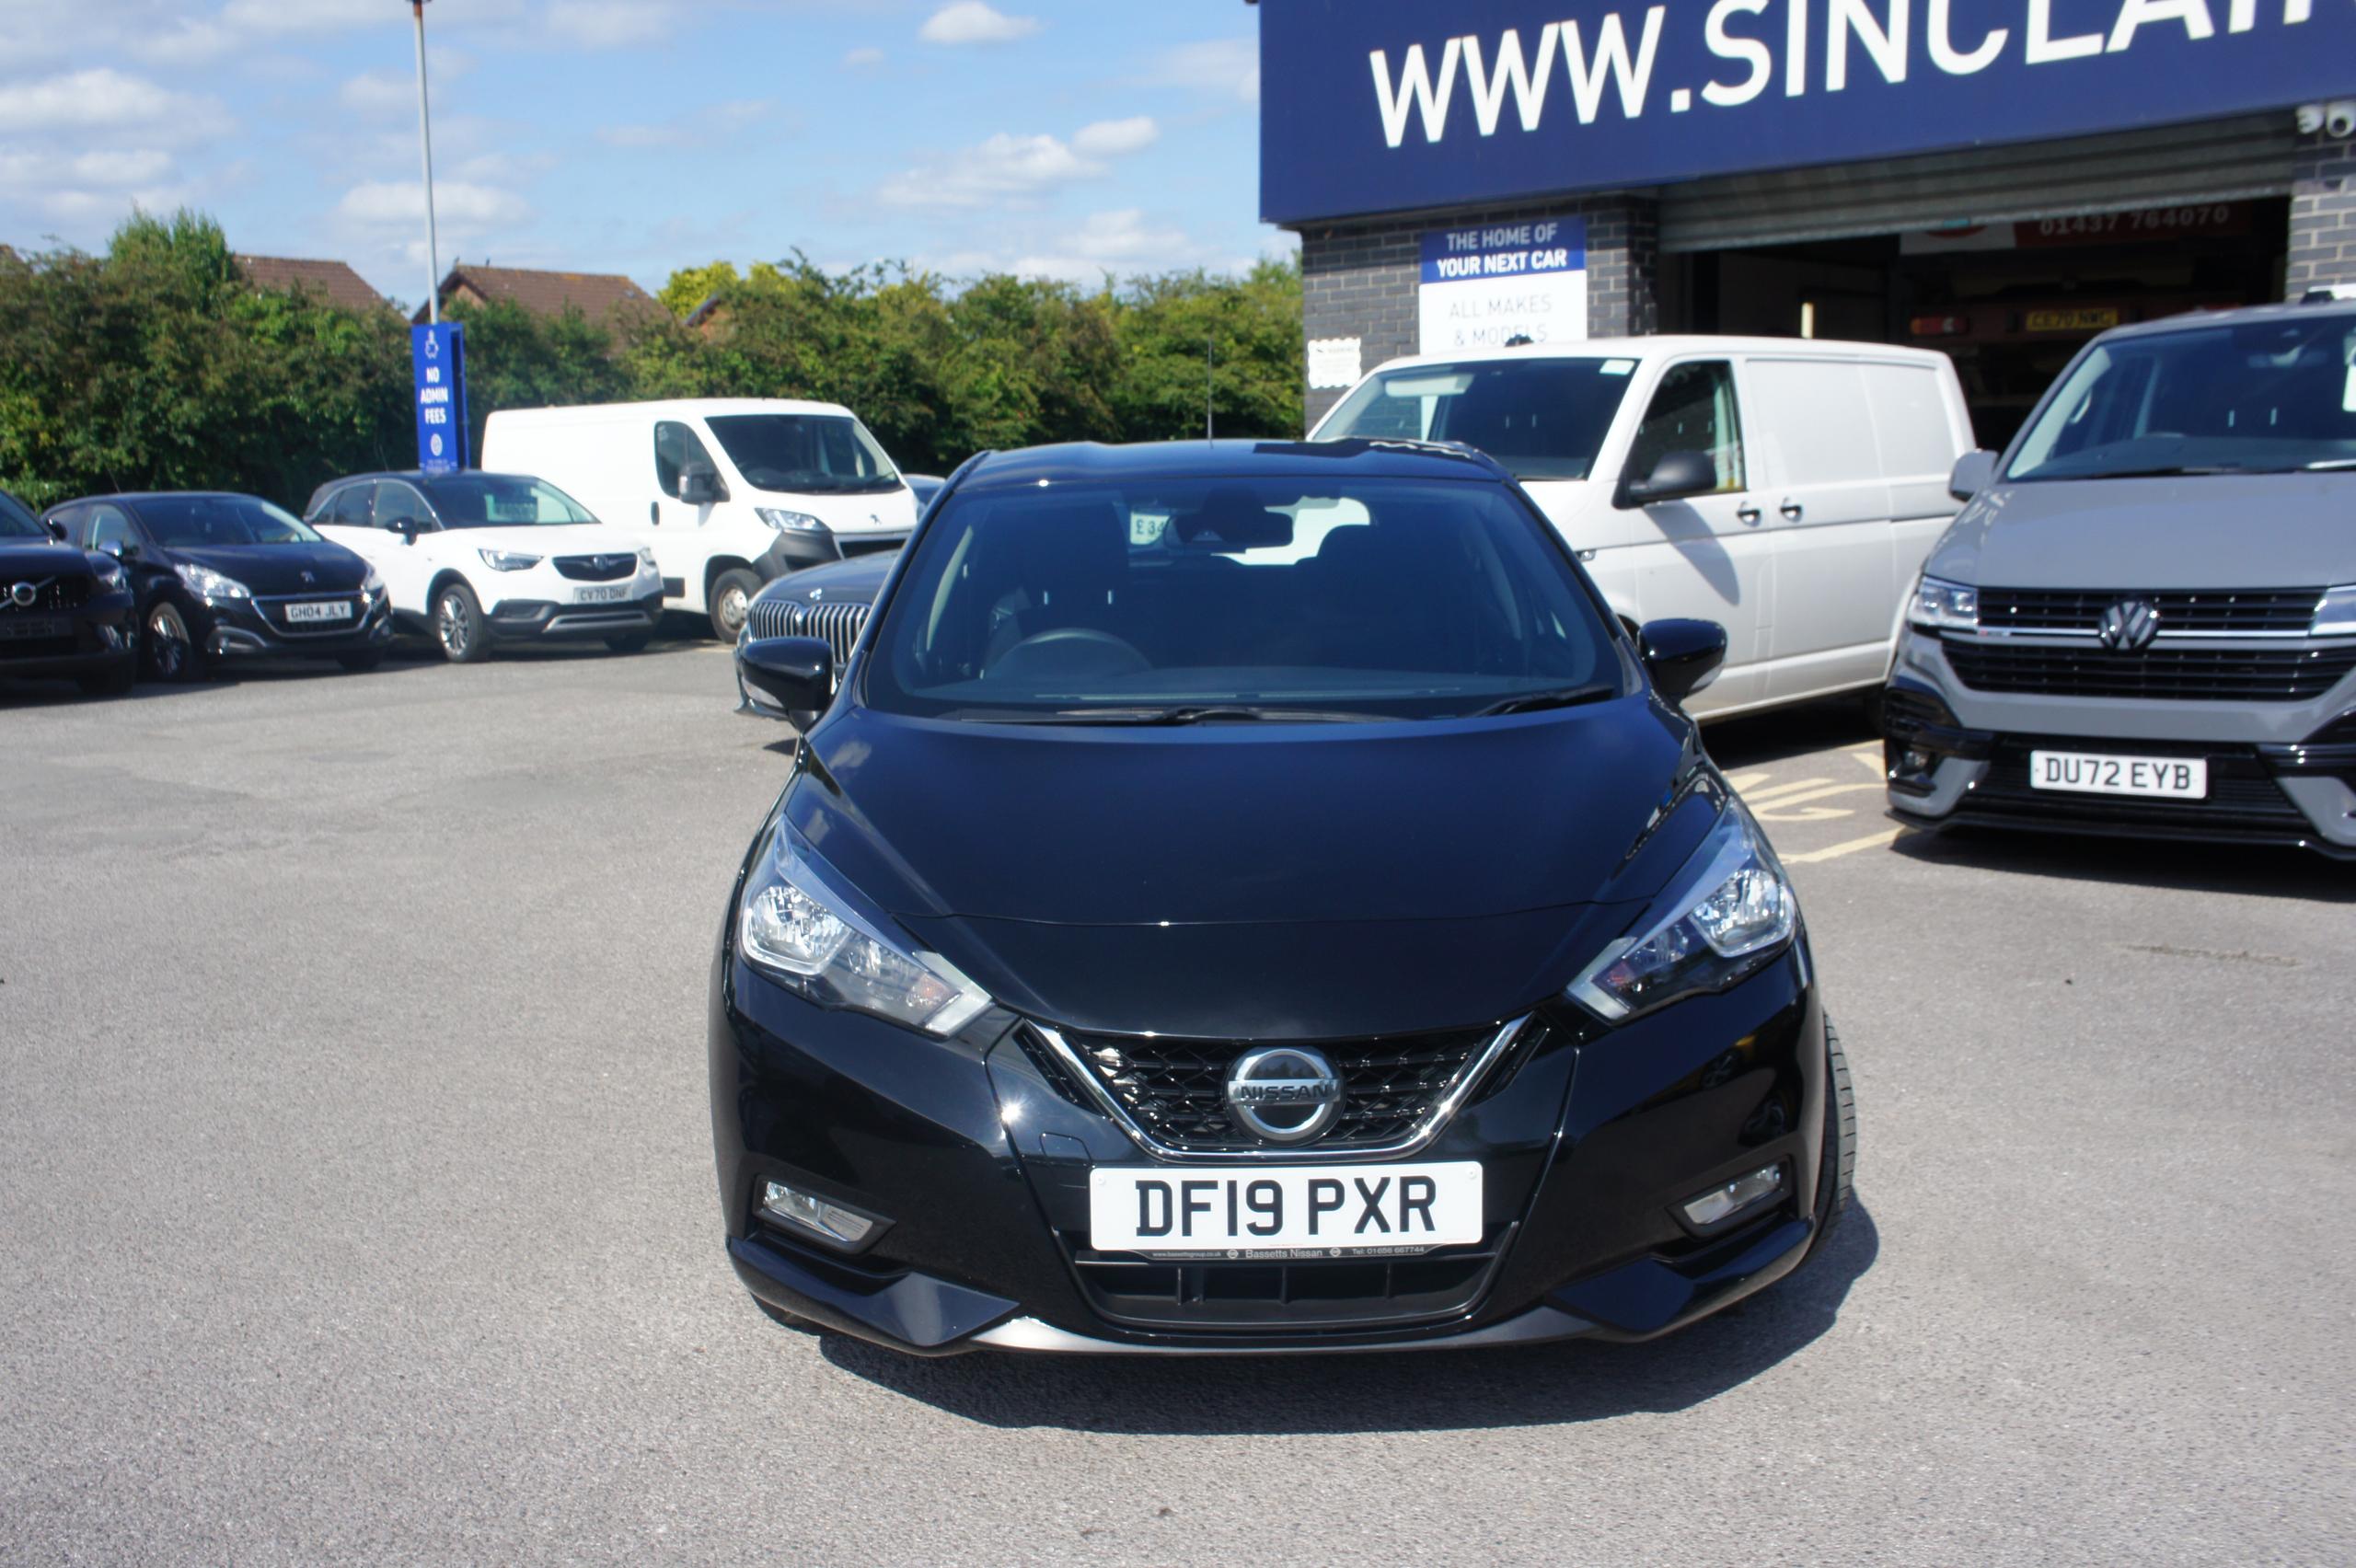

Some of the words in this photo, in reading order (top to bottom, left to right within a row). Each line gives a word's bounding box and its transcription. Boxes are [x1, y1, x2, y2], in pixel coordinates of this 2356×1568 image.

[2040, 214, 2119, 236] 01437
[2131, 206, 2229, 229] 764070
[1447, 231, 1478, 251] THE
[1482, 226, 1530, 248] HOME
[1534, 223, 1558, 243] OF
[1437, 256, 1481, 278] YOUR
[1484, 252, 1528, 274] NEXT
[1531, 248, 1567, 270] CAR
[1449, 300, 1483, 319] ALL
[1487, 294, 1553, 317] MAKES
[426, 367, 440, 383] NO
[421, 386, 448, 404] ADMIN
[425, 408, 446, 424] FEES
[2046, 758, 2120, 787] DU72
[2131, 762, 2191, 790] EYB
[1241, 1085, 1328, 1100] NISSAN
[1136, 1180, 1284, 1237] DF19
[1308, 1175, 1437, 1235] PXR
[1245, 1249, 1288, 1259] Bassetts
[1290, 1247, 1322, 1258] Nissan
